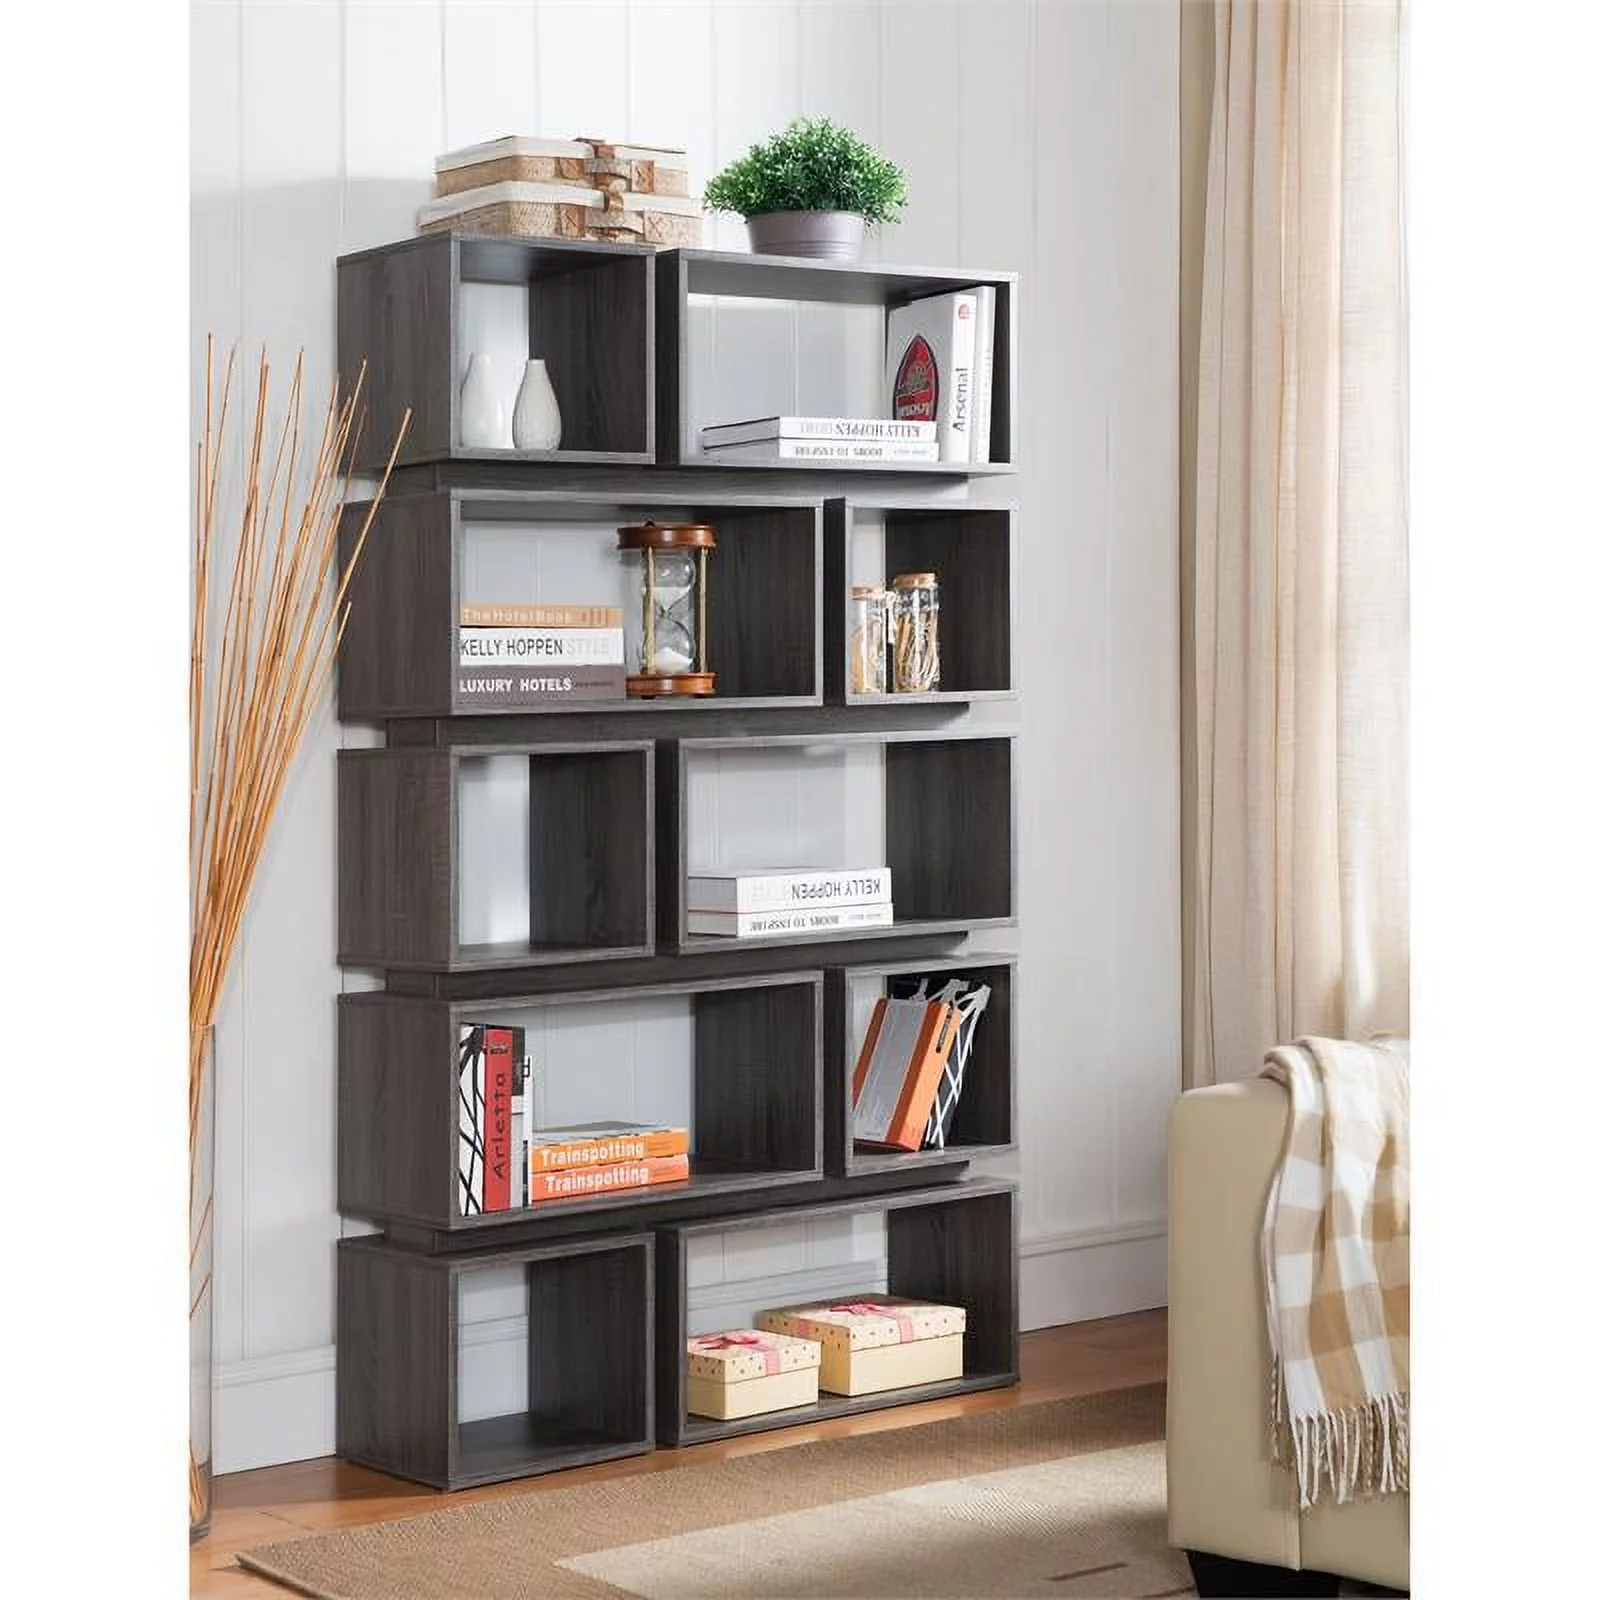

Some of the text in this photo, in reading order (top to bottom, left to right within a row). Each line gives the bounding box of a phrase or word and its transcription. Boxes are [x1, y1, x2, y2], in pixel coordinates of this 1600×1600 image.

[953, 367, 969, 432] Arsenal
[460, 639, 501, 656] KELLY
[507, 638, 563, 656] HOPPEN
[460, 679, 513, 693] LUXURY
[520, 678, 573, 692] HOTELS
[792, 883, 841, 899] HOPPEN
[845, 879, 881, 896] KELLY
[540, 1142, 645, 1167] Trainspotting
[545, 1166, 649, 1192] Trainspotting
